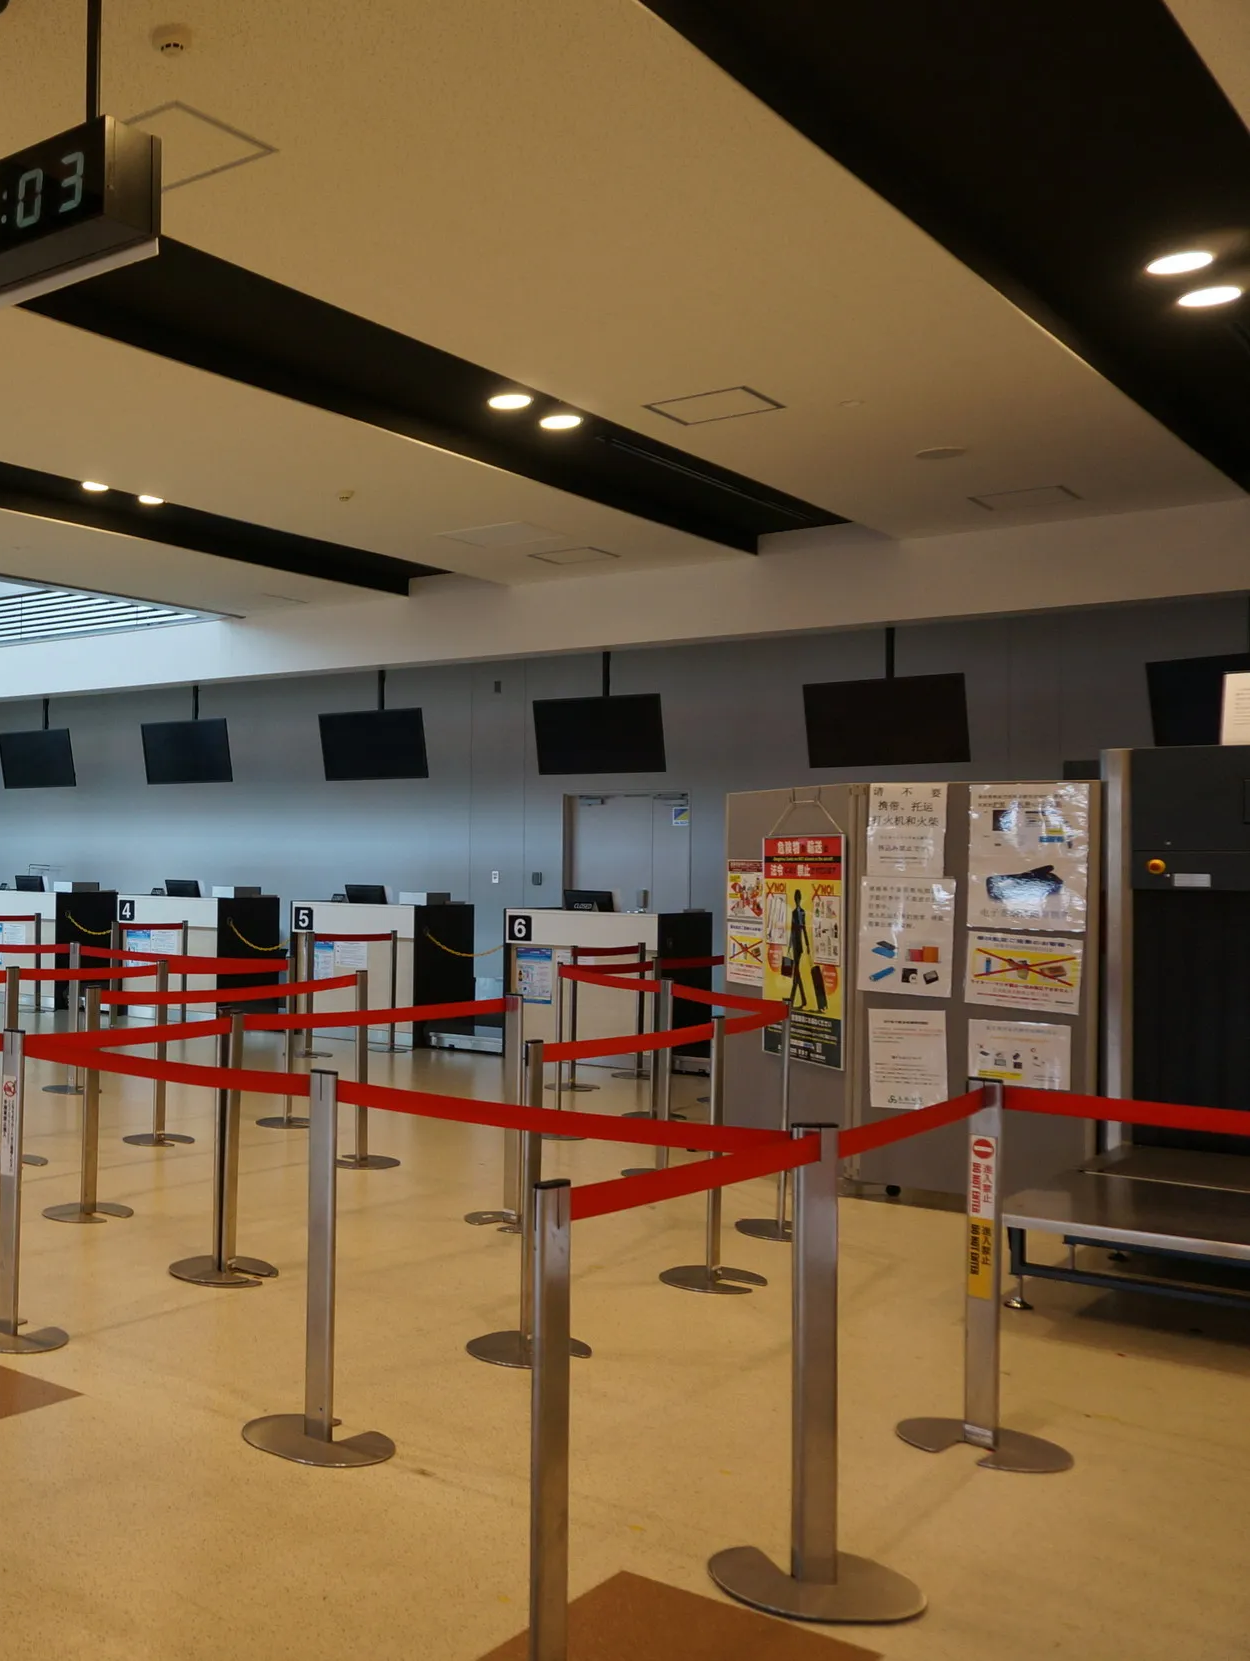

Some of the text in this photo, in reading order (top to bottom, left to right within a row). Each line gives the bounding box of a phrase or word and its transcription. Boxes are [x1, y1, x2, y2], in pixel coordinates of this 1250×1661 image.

[871, 815, 939, 827] 打火机和火柴
[122, 903, 131, 919] 4
[298, 909, 309, 927] 5
[513, 918, 526, 938] 6
